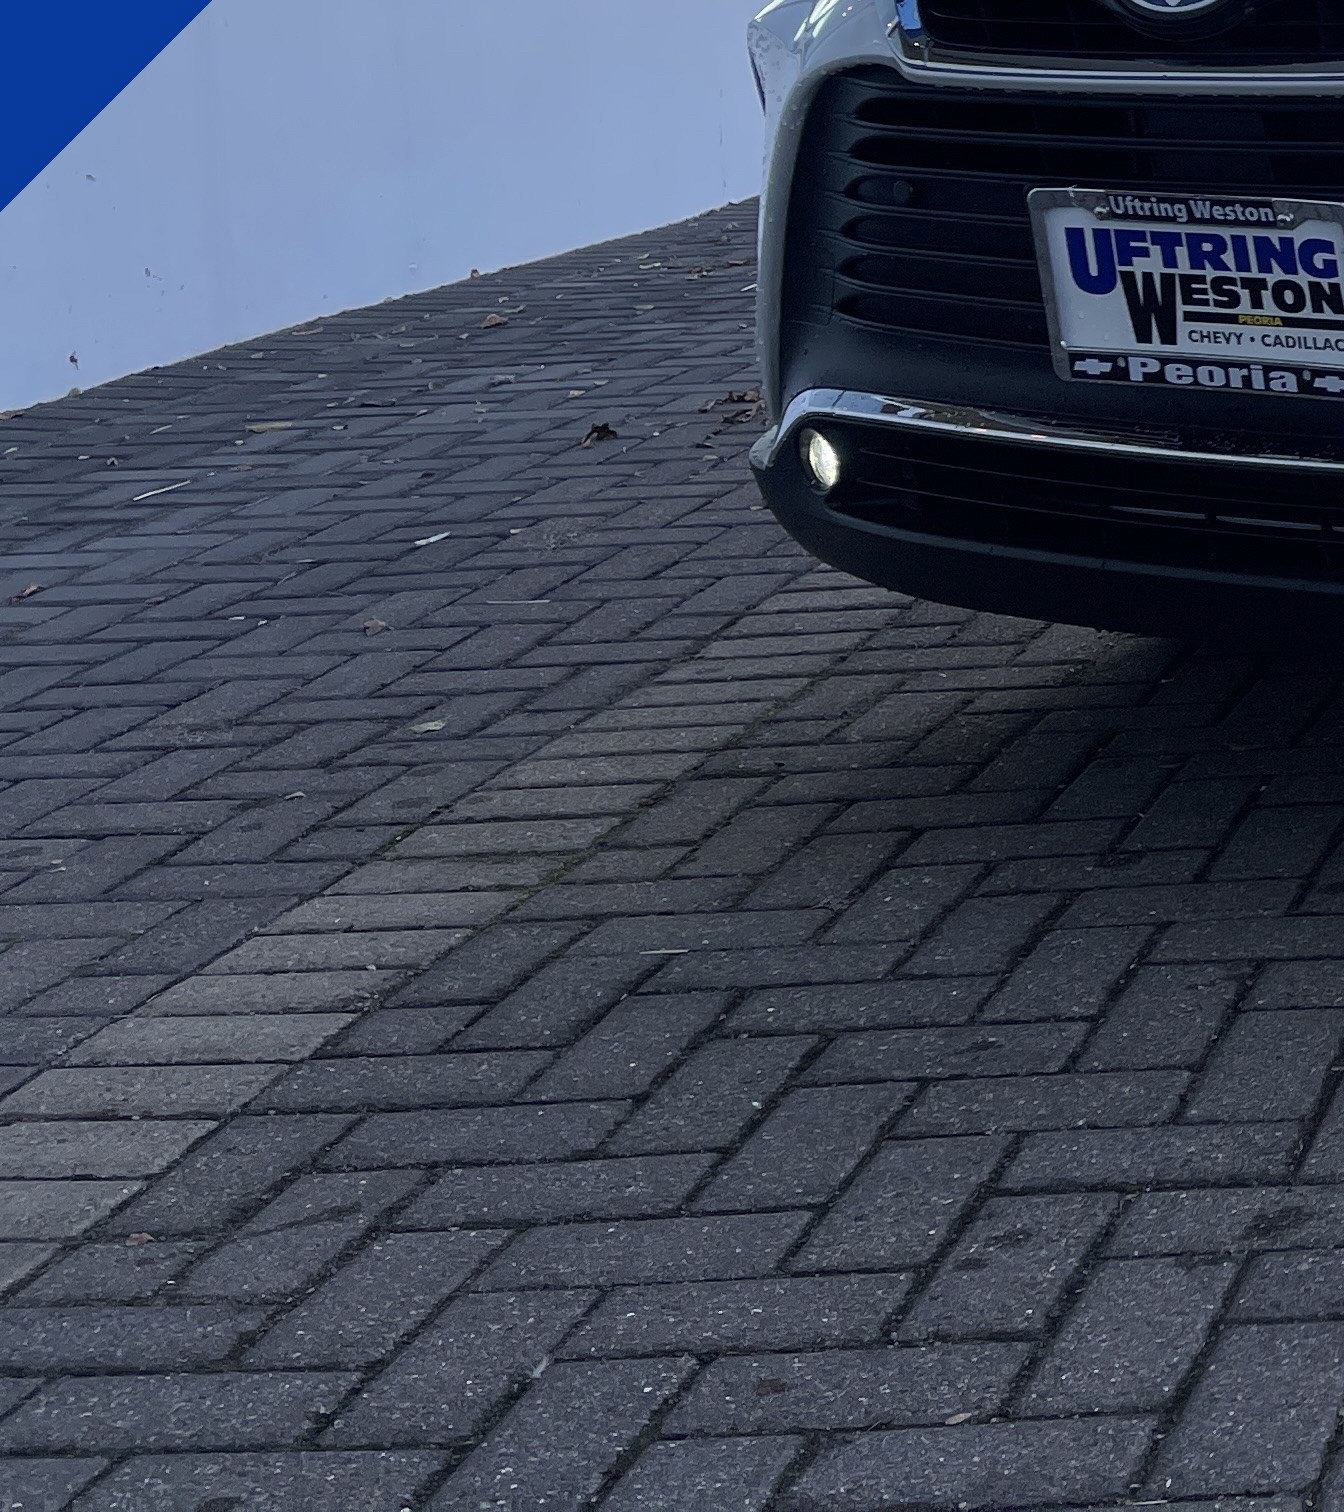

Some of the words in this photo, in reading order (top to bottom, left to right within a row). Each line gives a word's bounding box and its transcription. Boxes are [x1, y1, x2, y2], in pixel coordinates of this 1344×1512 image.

[1108, 195, 1188, 221] Uftring
[1189, 201, 1276, 223] Weston
[1064, 226, 1340, 295] UFTRING
[1237, 315, 1283, 327] PEORIA
[1187, 329, 1243, 346] CHEVY
[1127, 356, 1299, 393] Peoria
